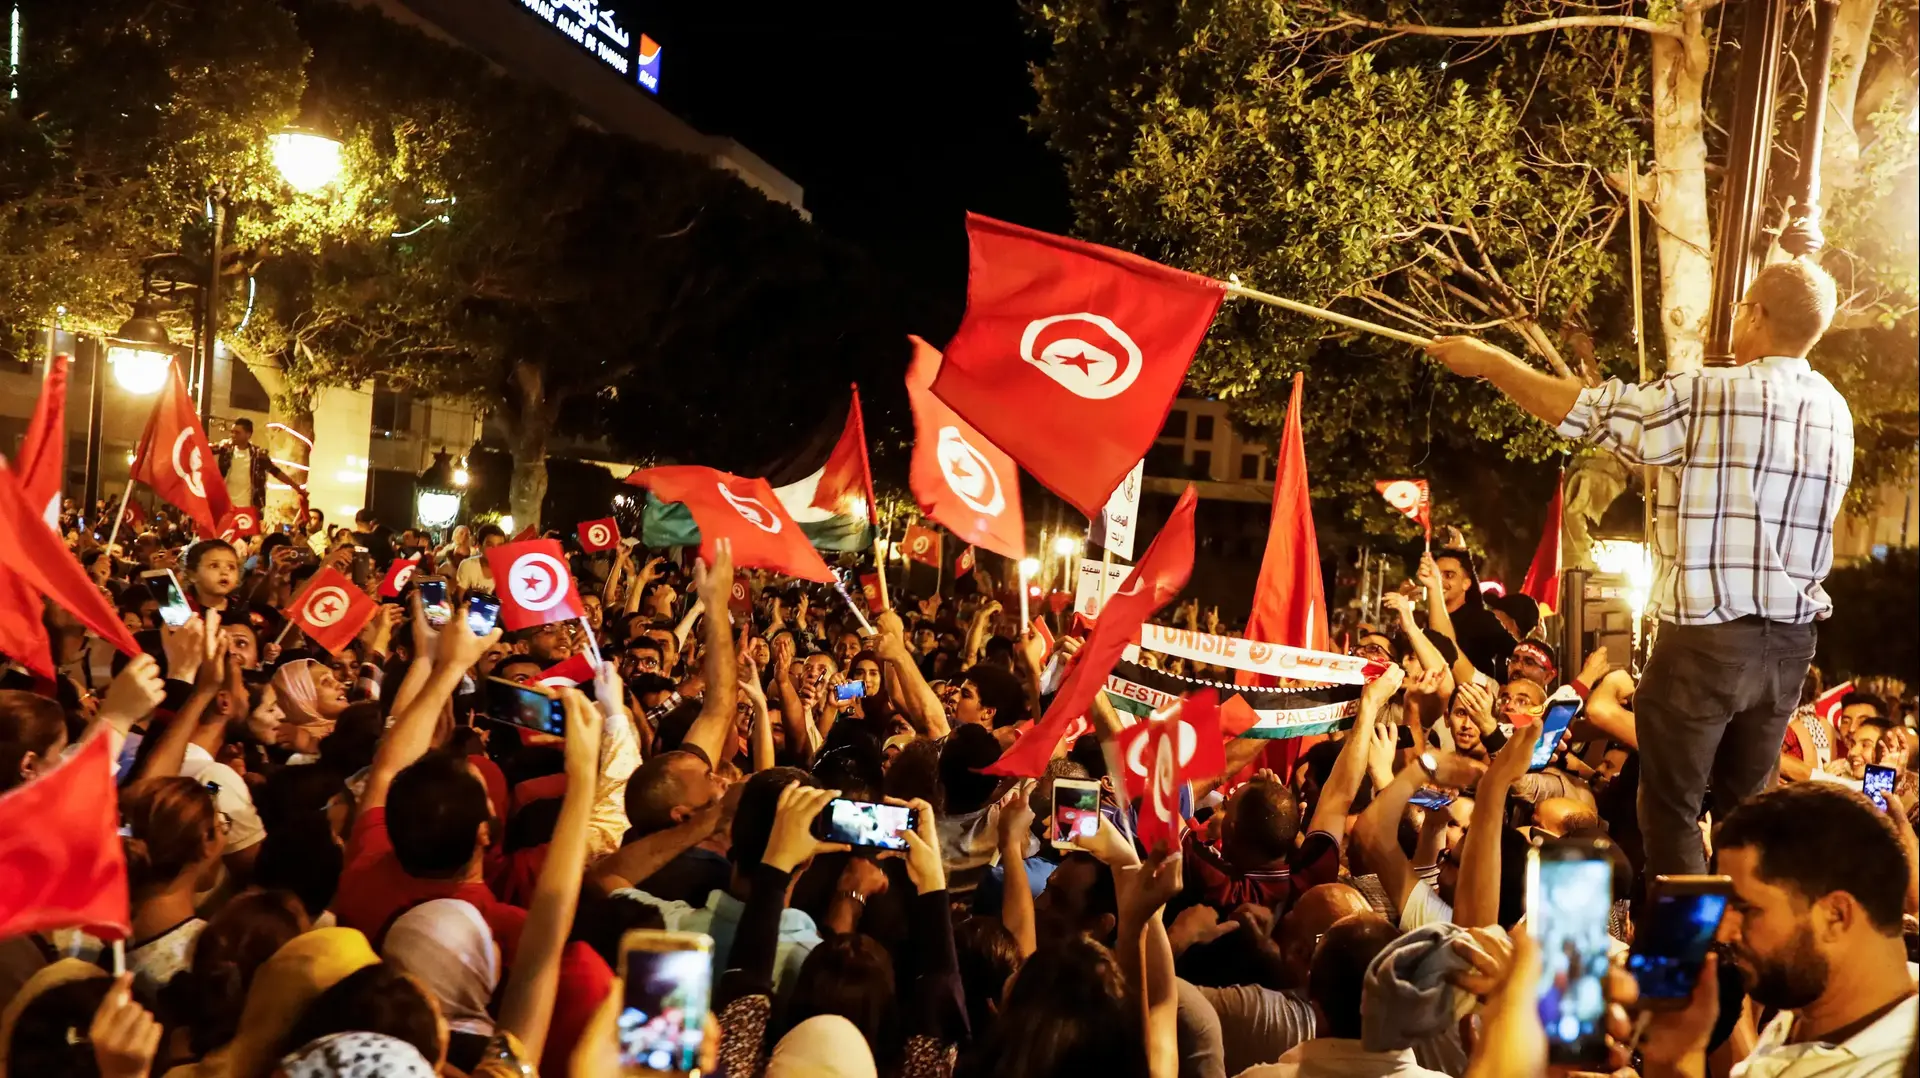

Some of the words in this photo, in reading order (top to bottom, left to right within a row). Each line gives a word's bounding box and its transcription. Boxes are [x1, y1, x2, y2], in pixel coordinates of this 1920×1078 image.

[585, 33, 597, 51] DE
[1151, 624, 1237, 657] TUNISIE
[1276, 700, 1356, 725] PALESTINE
